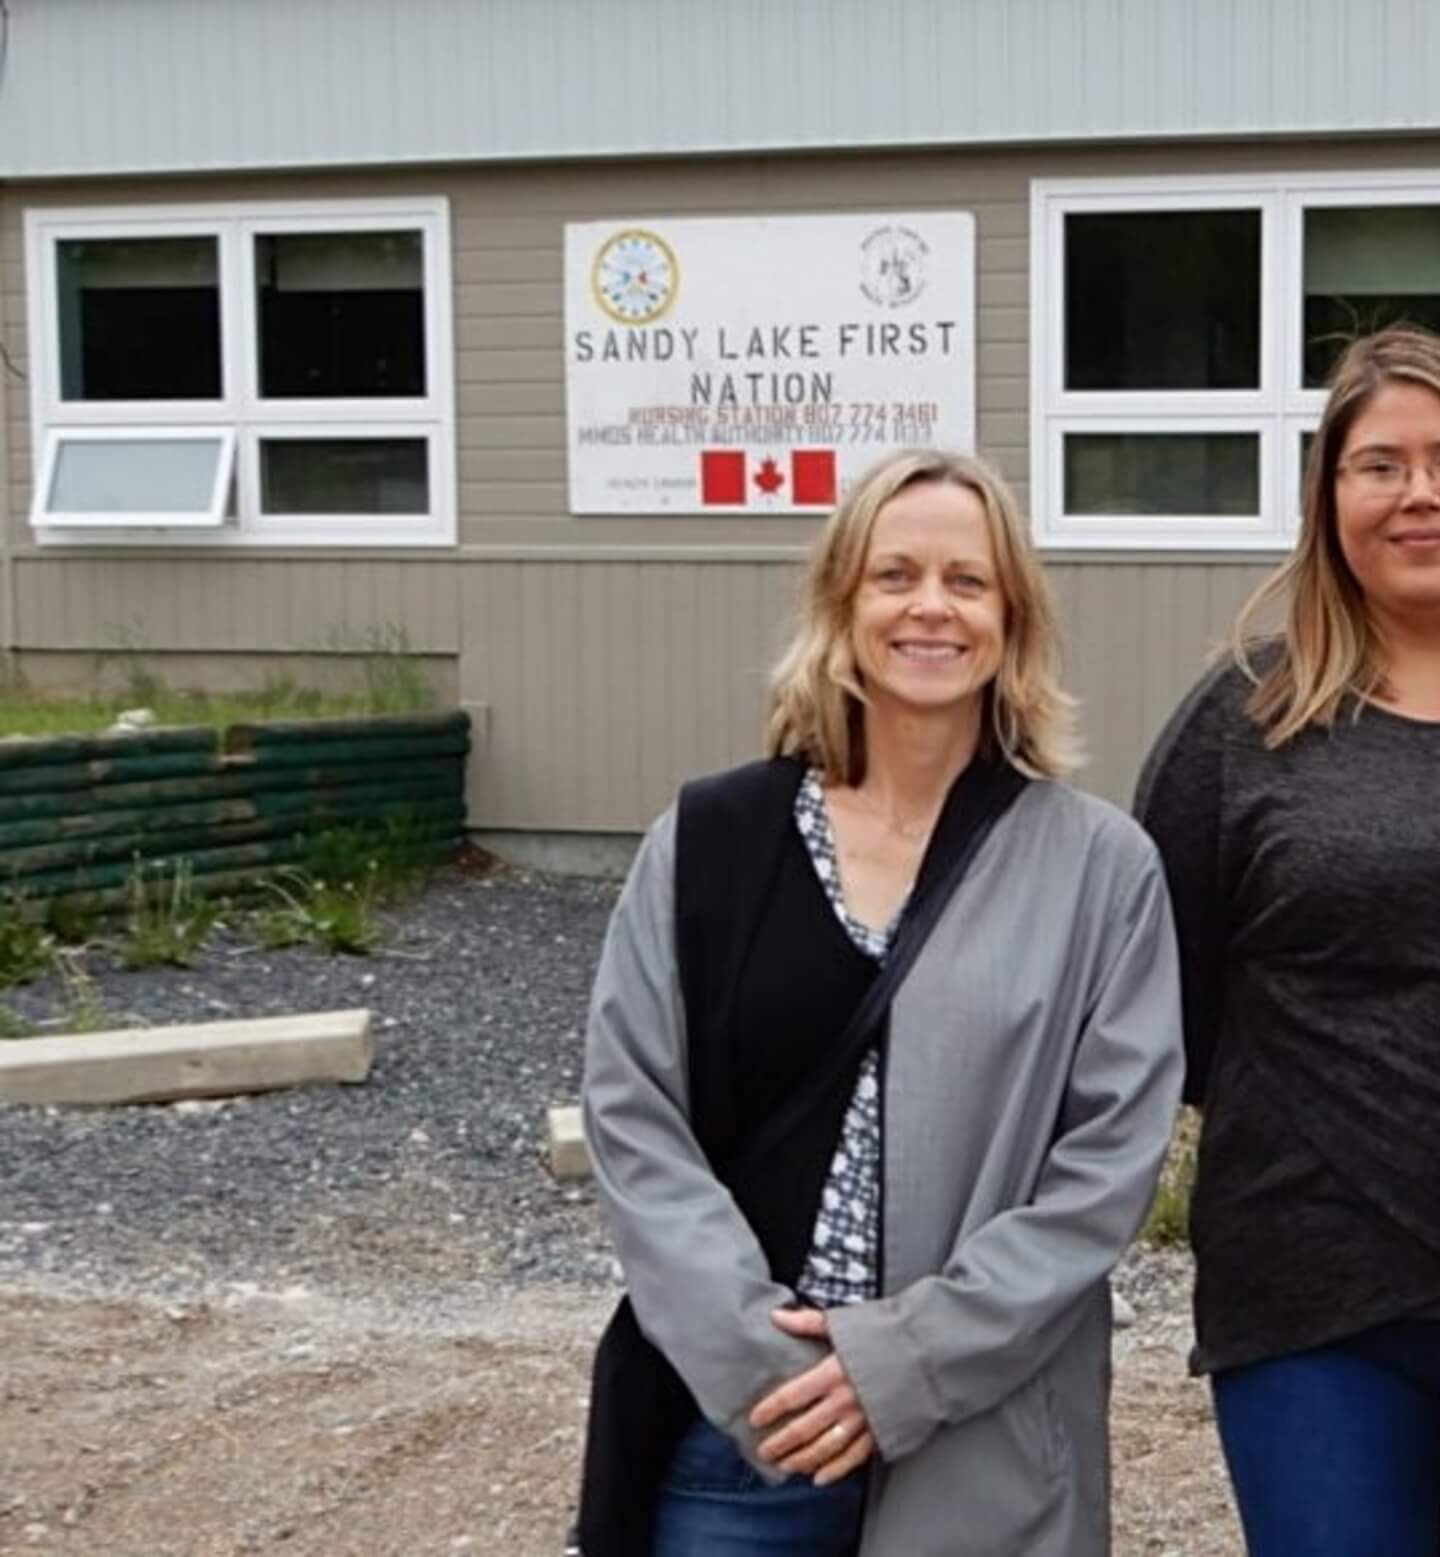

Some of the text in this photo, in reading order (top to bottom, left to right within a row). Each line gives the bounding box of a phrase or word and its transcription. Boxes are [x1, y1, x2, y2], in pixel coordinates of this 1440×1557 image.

[575, 321, 955, 362] SANDY LAKE FIRST
[690, 372, 834, 405] NATION
[628, 406, 708, 426] NURSING
[717, 405, 798, 425] STATION
[804, 404, 842, 425] 807
[849, 403, 887, 425] 774
[637, 425, 704, 445] HEALTH
